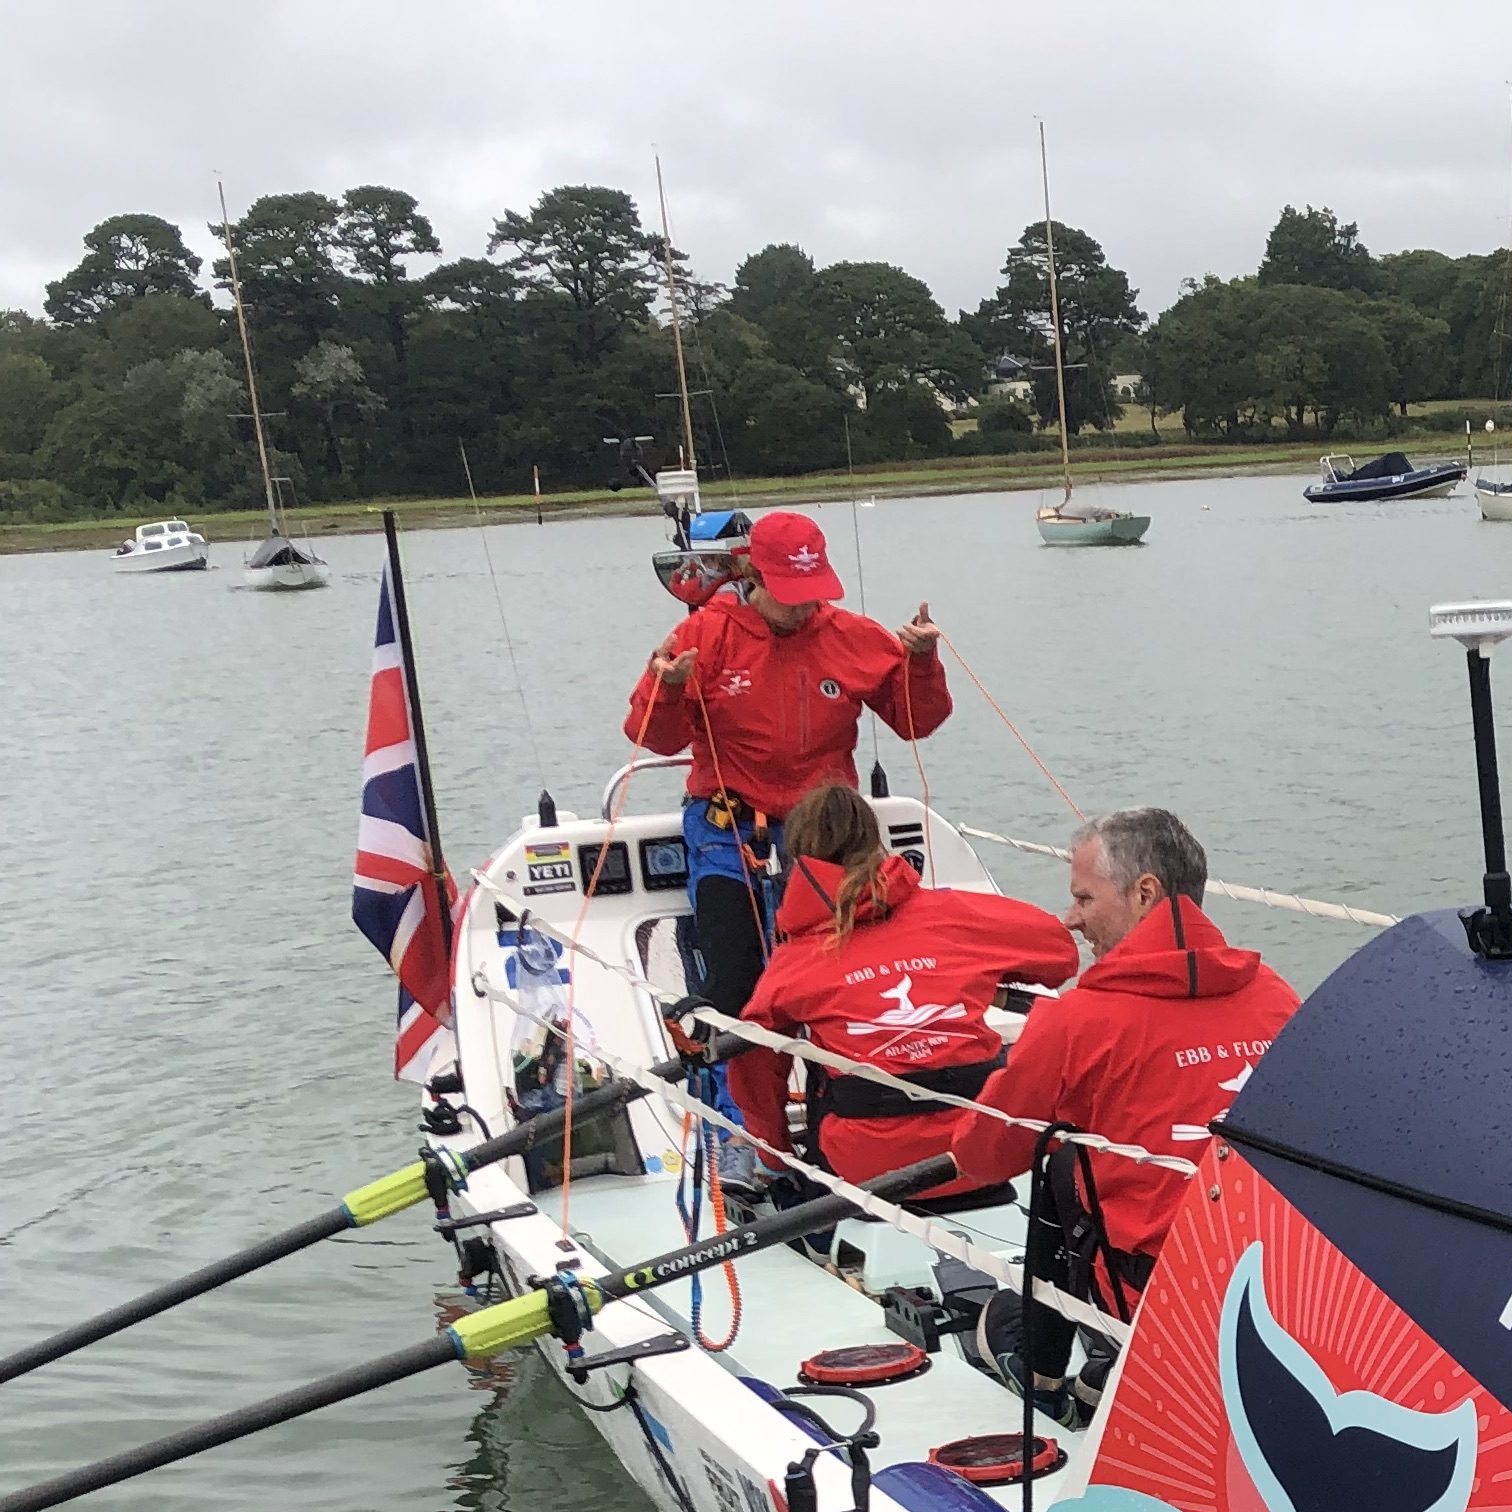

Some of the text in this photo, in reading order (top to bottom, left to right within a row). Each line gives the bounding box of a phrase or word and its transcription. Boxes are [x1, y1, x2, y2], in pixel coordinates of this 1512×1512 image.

[530, 863, 570, 880] YETI
[845, 957, 937, 985] EBB & FLOW
[884, 1035, 949, 1057] ATLANTIC ROW
[1174, 1046, 1212, 1068] EBB
[1216, 1044, 1229, 1059] &
[656, 1231, 758, 1277] concept 2
